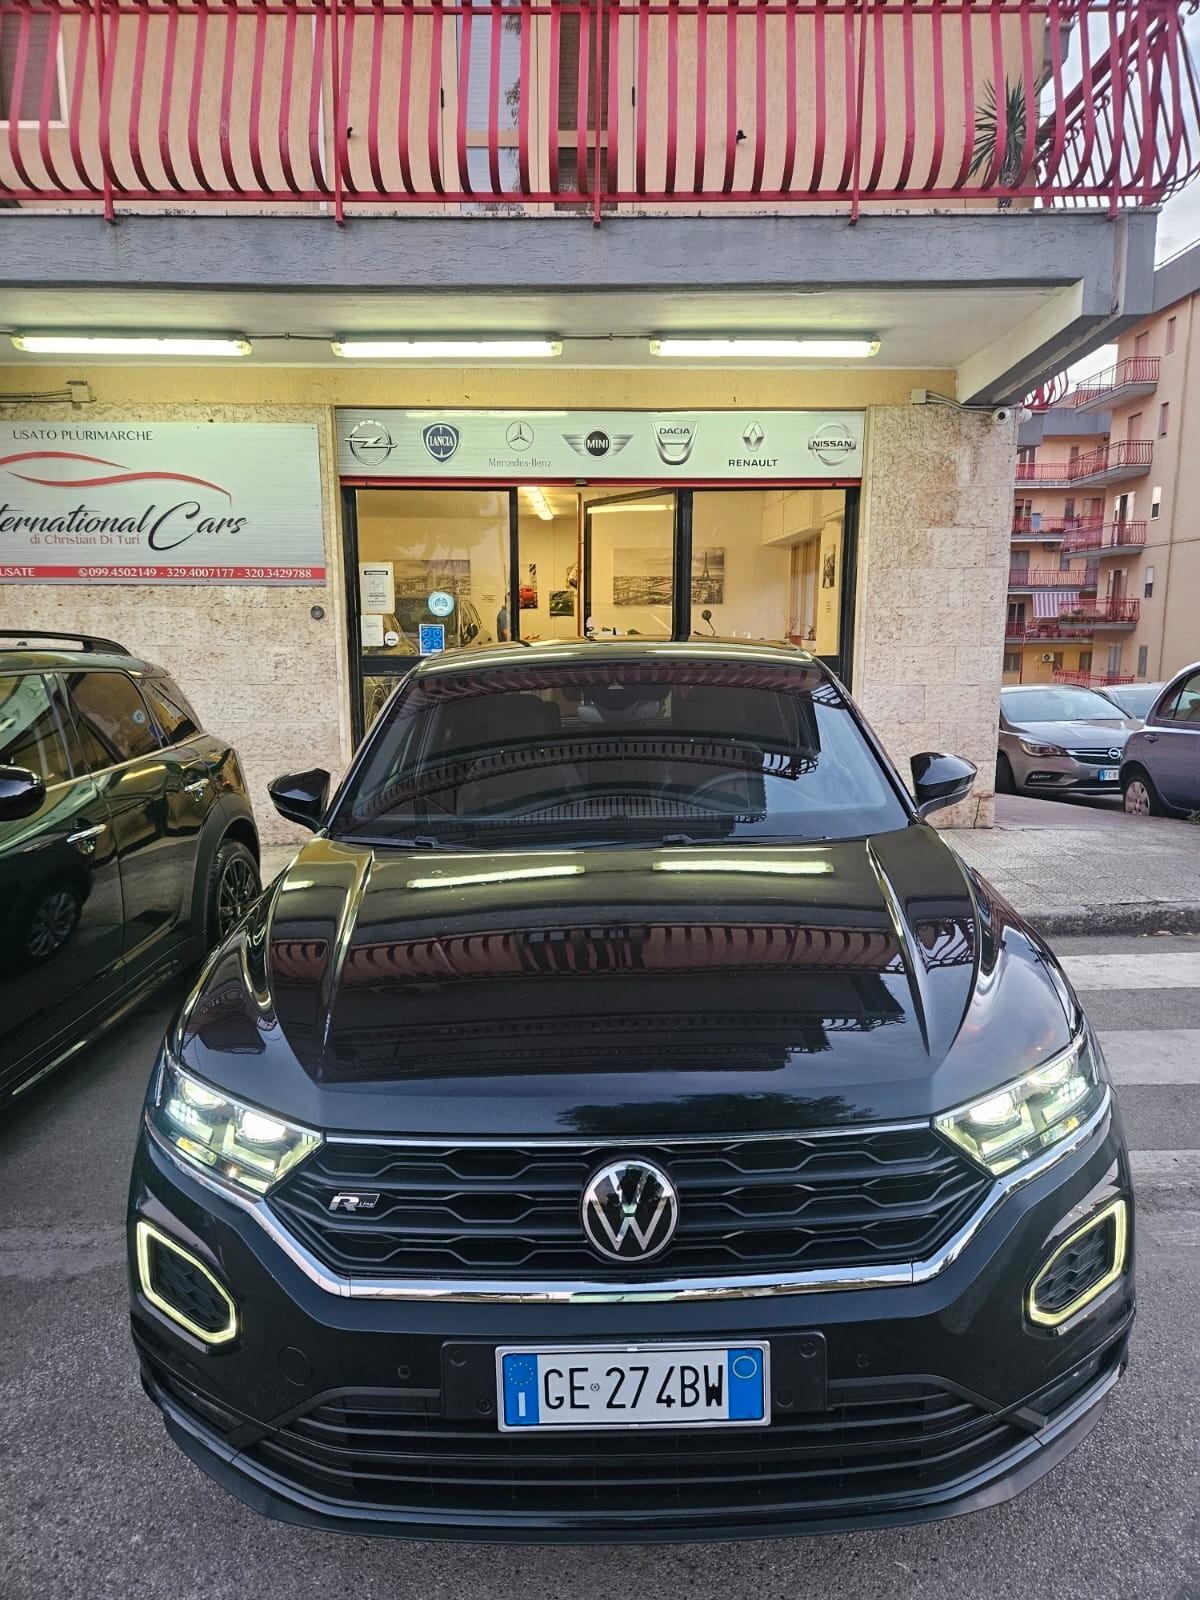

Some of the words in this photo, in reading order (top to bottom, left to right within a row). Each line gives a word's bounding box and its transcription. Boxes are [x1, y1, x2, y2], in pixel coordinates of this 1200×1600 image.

[13, 430, 57, 440] USATO
[61, 430, 154, 441] PLURIMARCHE
[660, 427, 691, 435] DACIA
[429, 435, 454, 447] LANCIA
[586, 439, 609, 449] MINI
[812, 440, 852, 448] NISSAN
[488, 457, 552, 467] Mercedes-Benz
[728, 458, 779, 467] RENAULT
[148, 501, 249, 551] Cars
[30, 534, 40, 545] di
[44, 534, 97, 545] Christian
[100, 534, 113, 545] Di
[118, 534, 140, 545] Turi
[0, 567, 36, 577] USATE
[88, 567, 156, 578] 099.4502149
[166, 568, 235, 578] 329.4007177
[244, 568, 312, 579] 320.3429788
[543, 1367, 590, 1410] GE
[605, 1365, 724, 1409] 274BW
